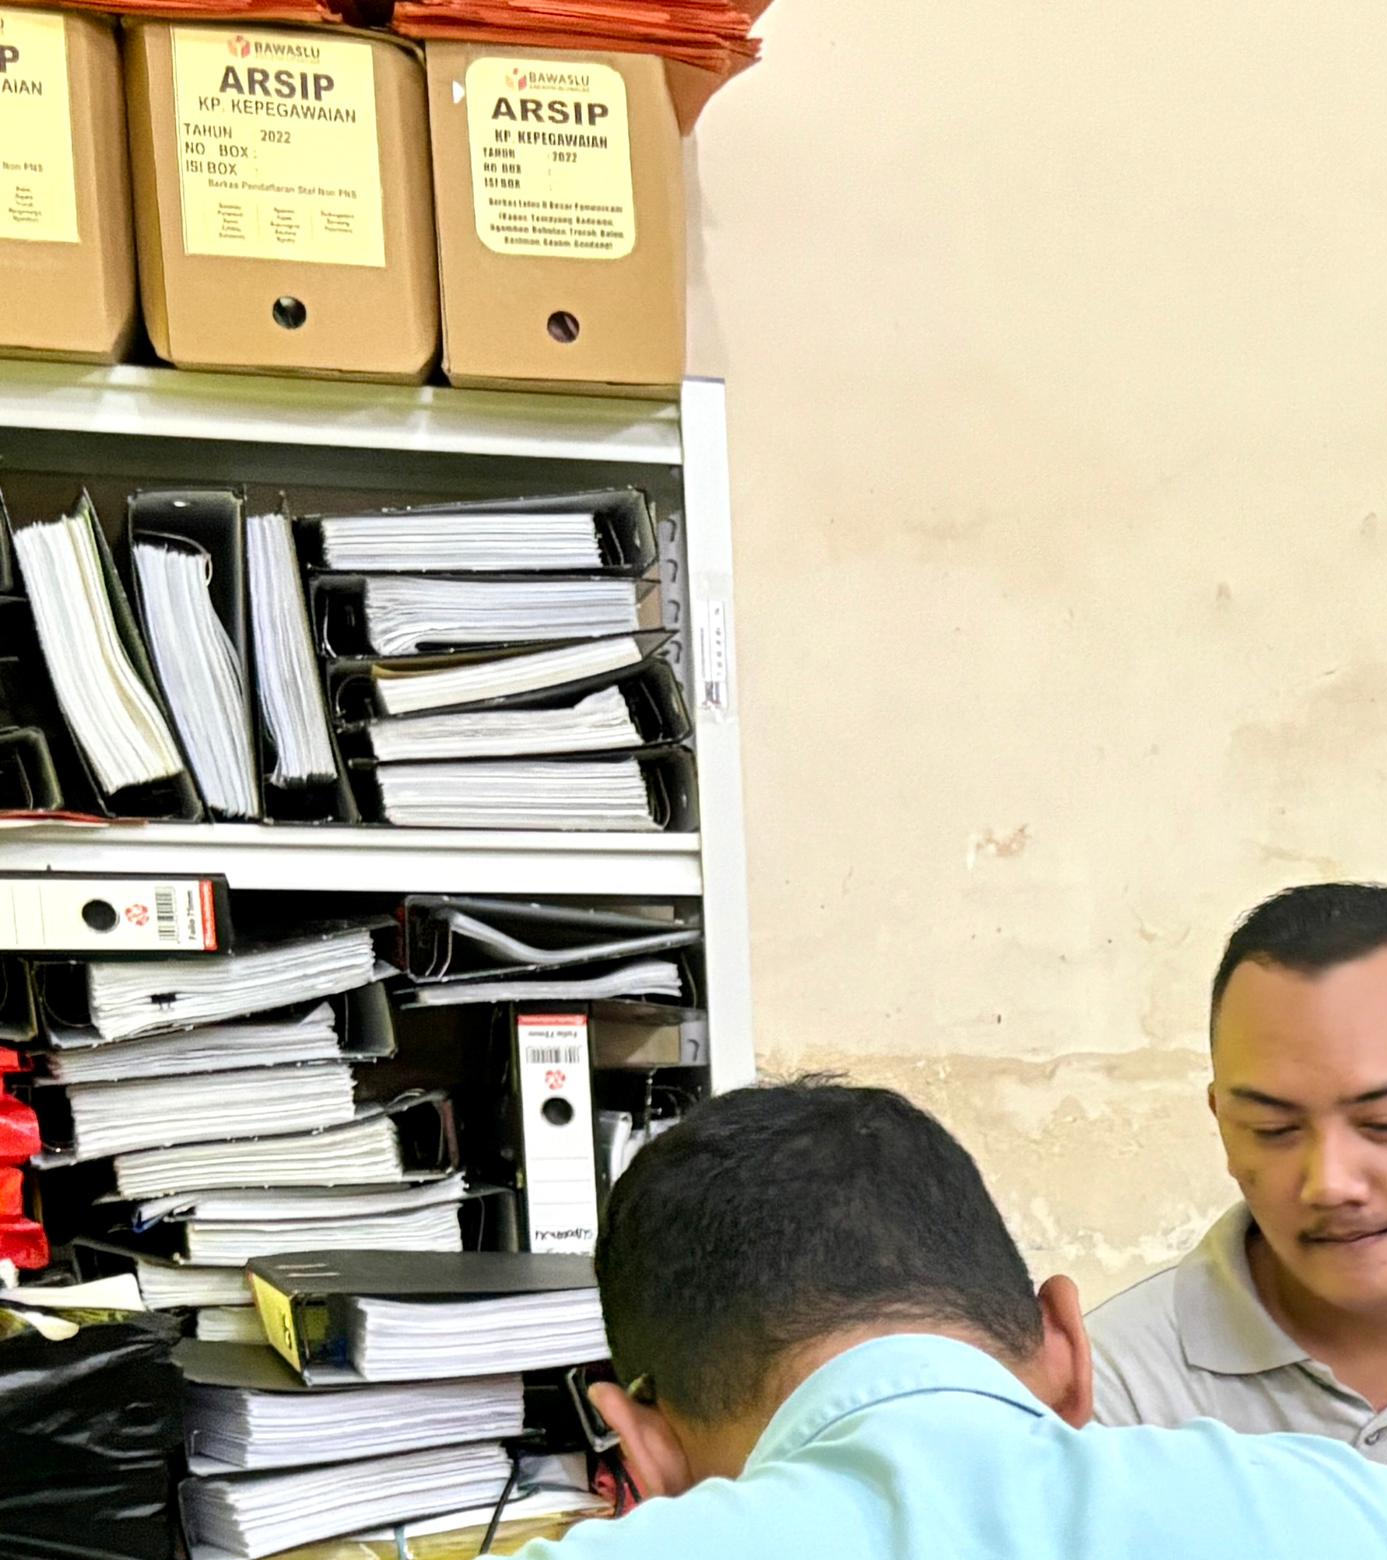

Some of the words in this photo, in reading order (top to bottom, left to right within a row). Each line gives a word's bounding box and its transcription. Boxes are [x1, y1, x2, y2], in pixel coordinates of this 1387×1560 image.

[254, 41, 320, 59] BAWASLU
[219, 65, 335, 101] ARSIP
[529, 72, 590, 87] BAWASLU
[231, 99, 356, 123] KEPEGAWAIAN
[491, 97, 609, 126] ARSIP
[184, 123, 233, 139] TAHUN
[260, 129, 291, 144] 2022
[518, 130, 608, 149] KEPEGAWAIAN
[185, 142, 206, 155] NO
[185, 160, 204, 173] ISI
[207, 161, 238, 176] BOX
